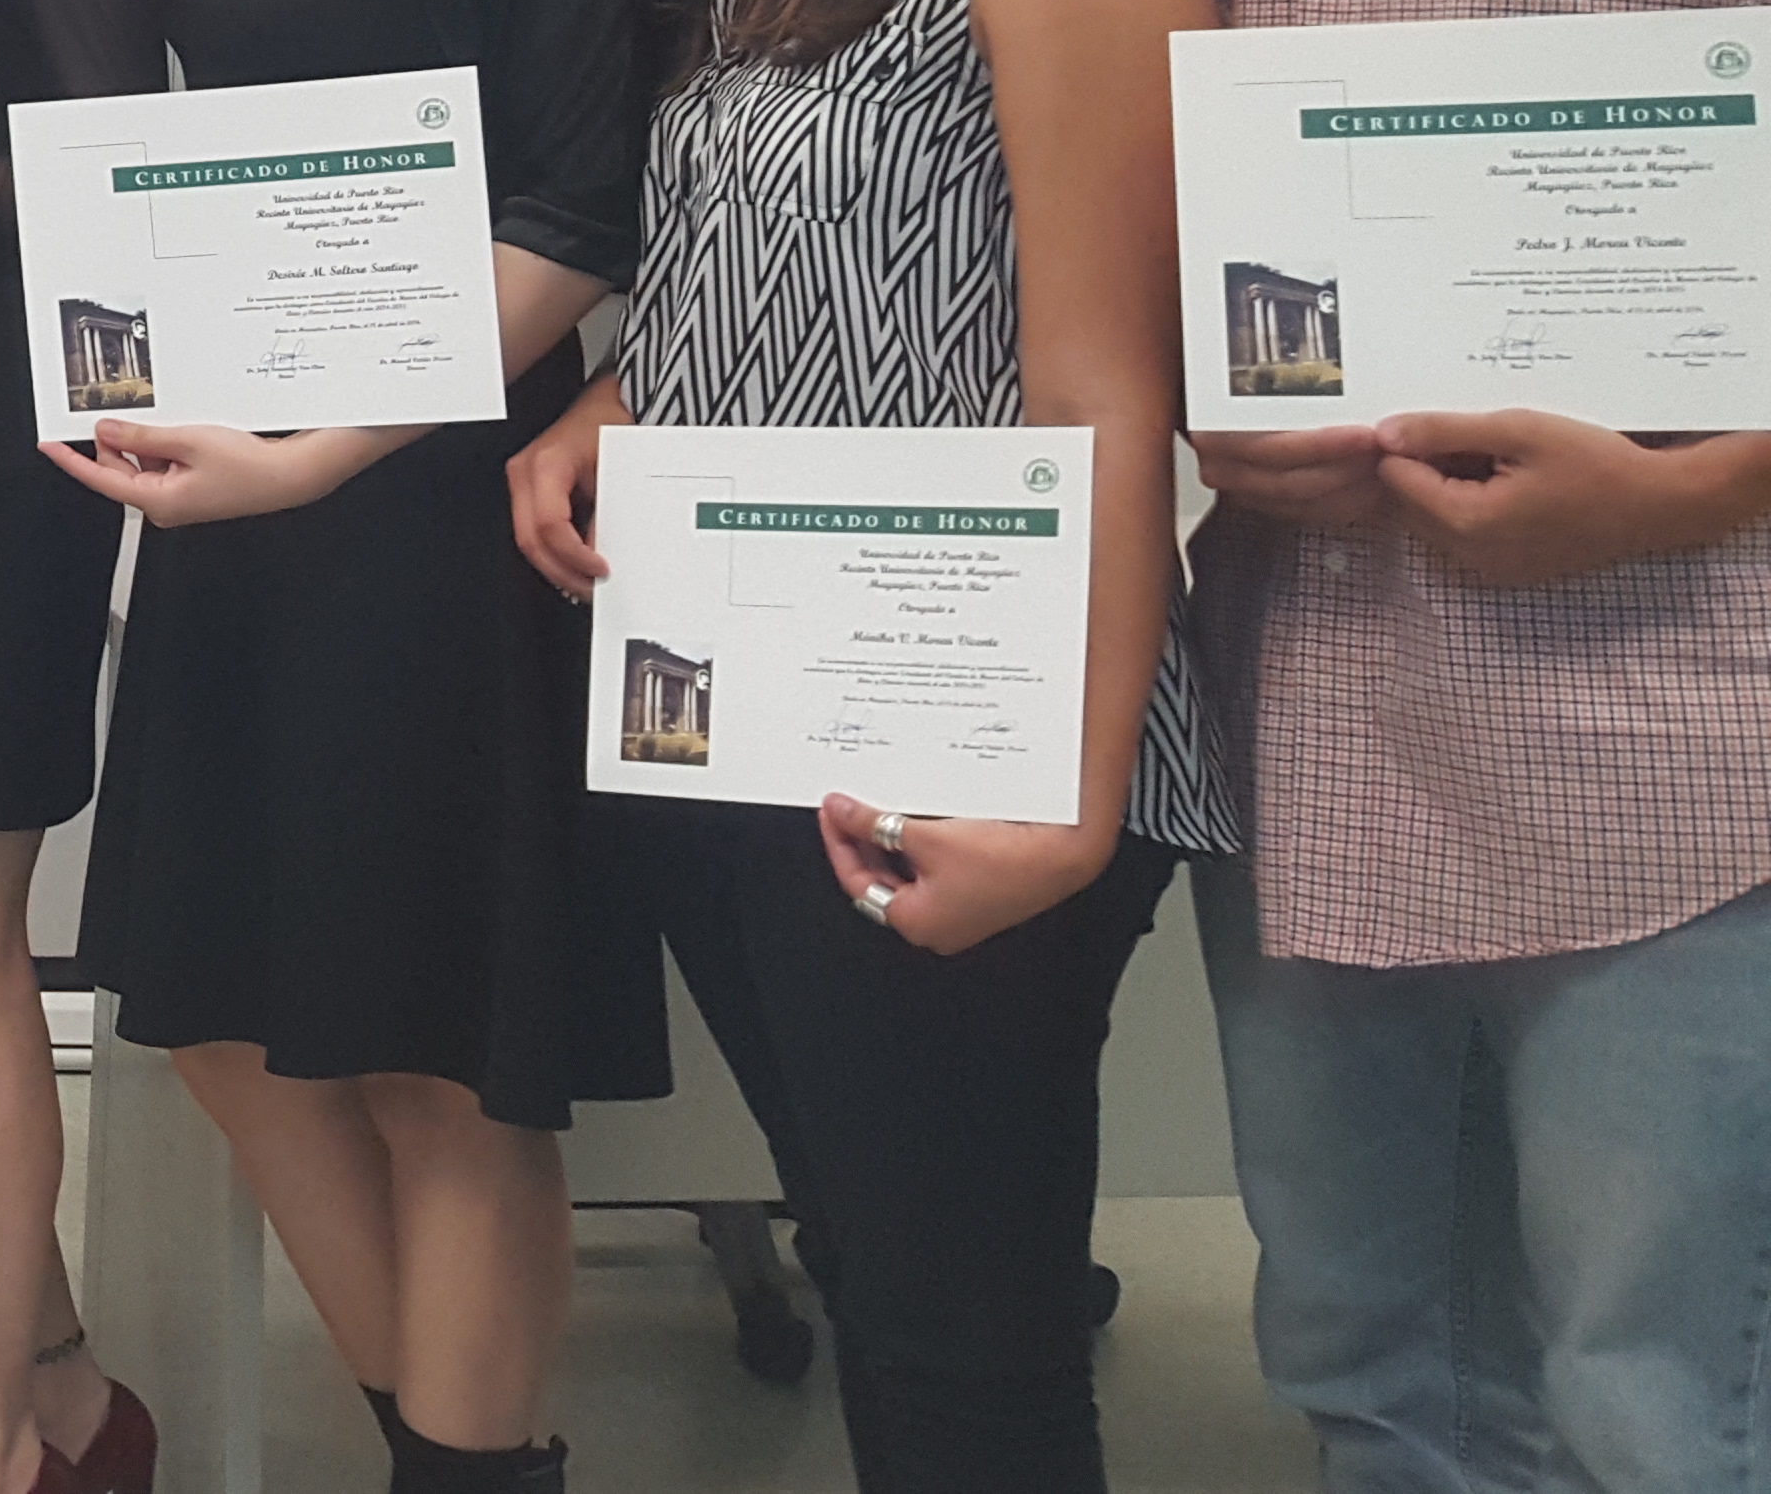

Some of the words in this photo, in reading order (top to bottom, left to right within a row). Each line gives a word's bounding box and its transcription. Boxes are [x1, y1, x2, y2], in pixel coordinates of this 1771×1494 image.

[1329, 112, 1530, 132] CERTIFICADO
[1550, 110, 1584, 125] DE
[1605, 105, 1716, 123] HONOR
[1509, 146, 1587, 159] Universidad
[1590, 146, 1605, 157] de
[1608, 145, 1652, 156] Puerto
[1656, 144, 1686, 155] Rico
[134, 163, 288, 186] CERTIFICADO
[302, 160, 329, 174] DE
[342, 152, 426, 170] HONOR
[1621, 162, 1638, 173] de
[1601, 178, 1643, 190] Puerto
[1648, 178, 1678, 188] Rico
[272, 190, 331, 204] Universidad
[332, 189, 344, 200] de
[346, 188, 379, 198] Puerto
[381, 185, 404, 196] Rico
[356, 201, 369, 211] de
[341, 216, 374, 226] Puerto
[376, 214, 399, 224] Rico
[1514, 237, 1557, 251] Pedro
[370, 262, 419, 274] Santiago
[718, 508, 878, 528] CERTIFICADO
[894, 515, 921, 528] DE
[938, 513, 1027, 530] HONOR
